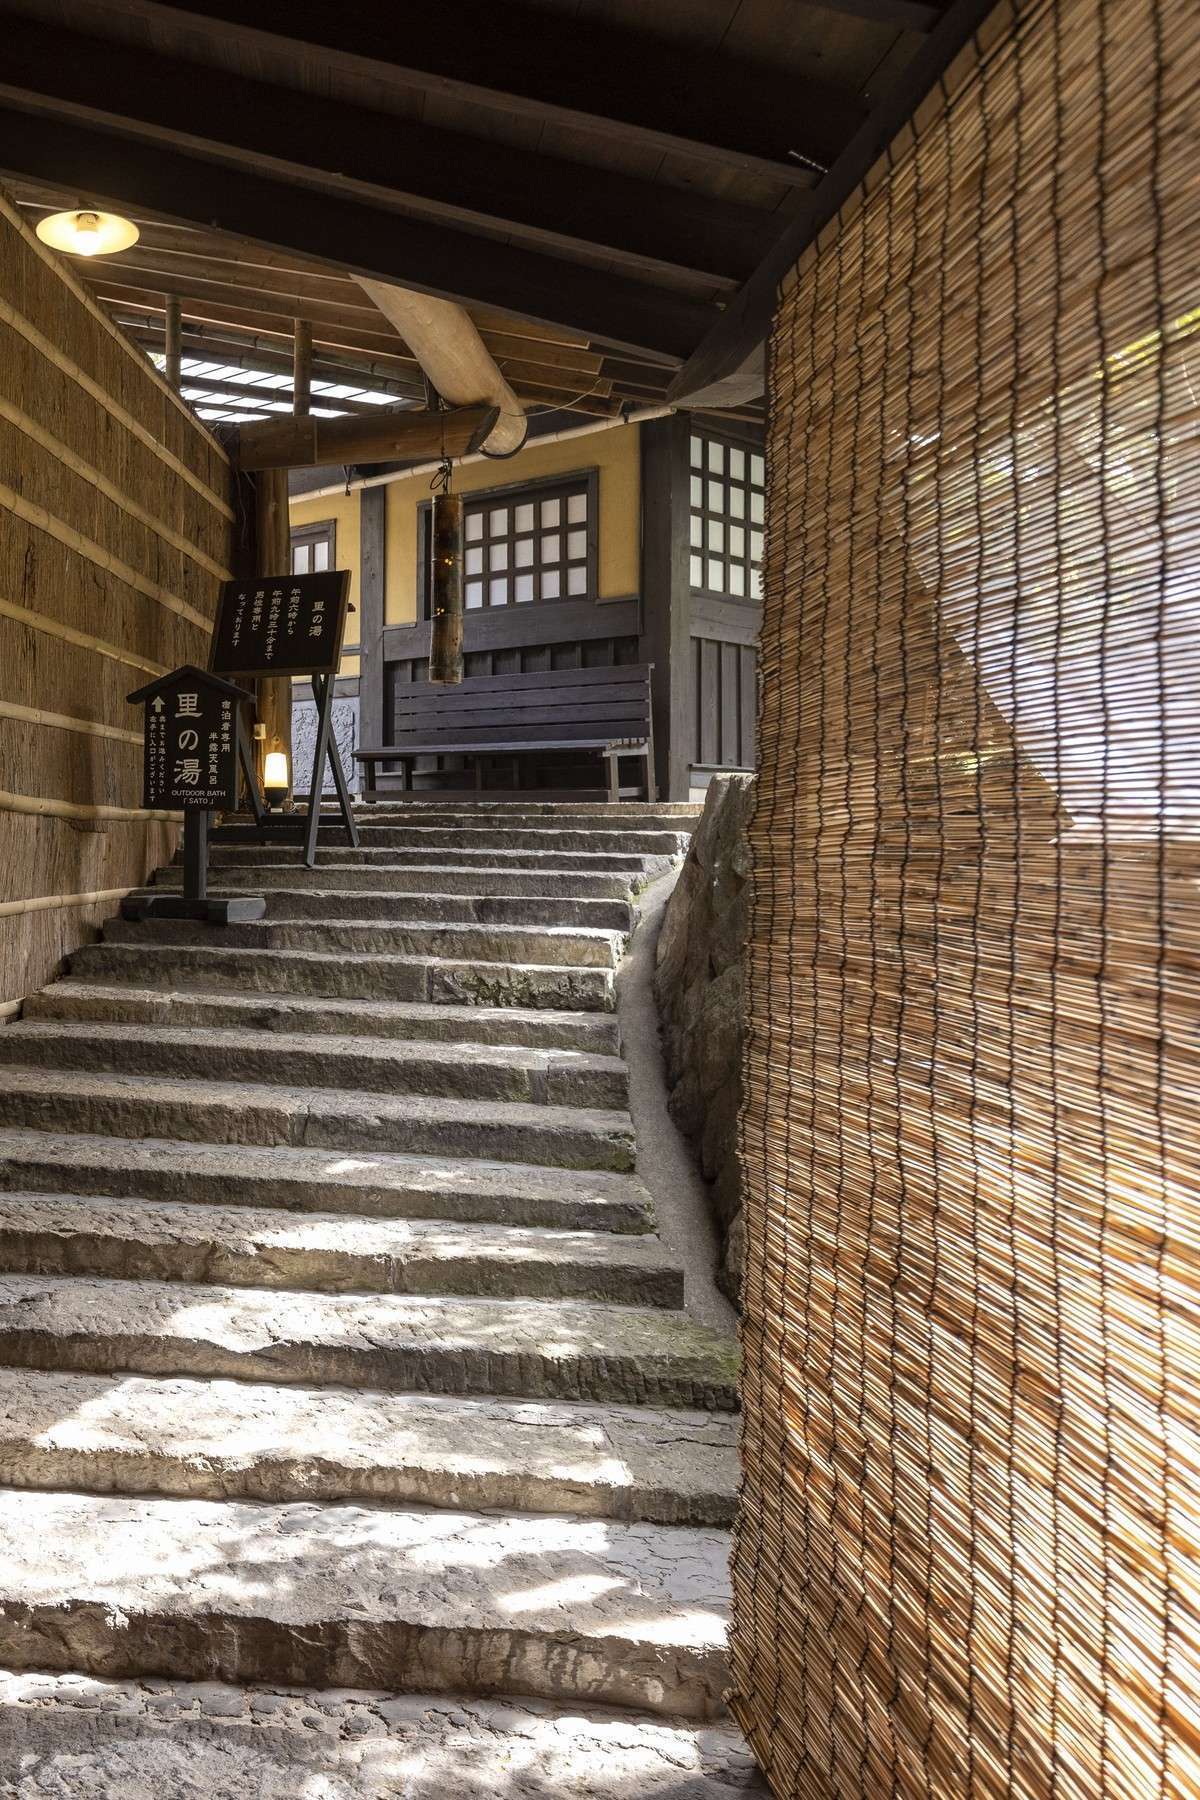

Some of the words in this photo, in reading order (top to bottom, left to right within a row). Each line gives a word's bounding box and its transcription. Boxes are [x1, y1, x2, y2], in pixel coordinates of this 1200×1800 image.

[309, 601, 325, 637] 里の湯
[174, 693, 203, 785] 里の湯
